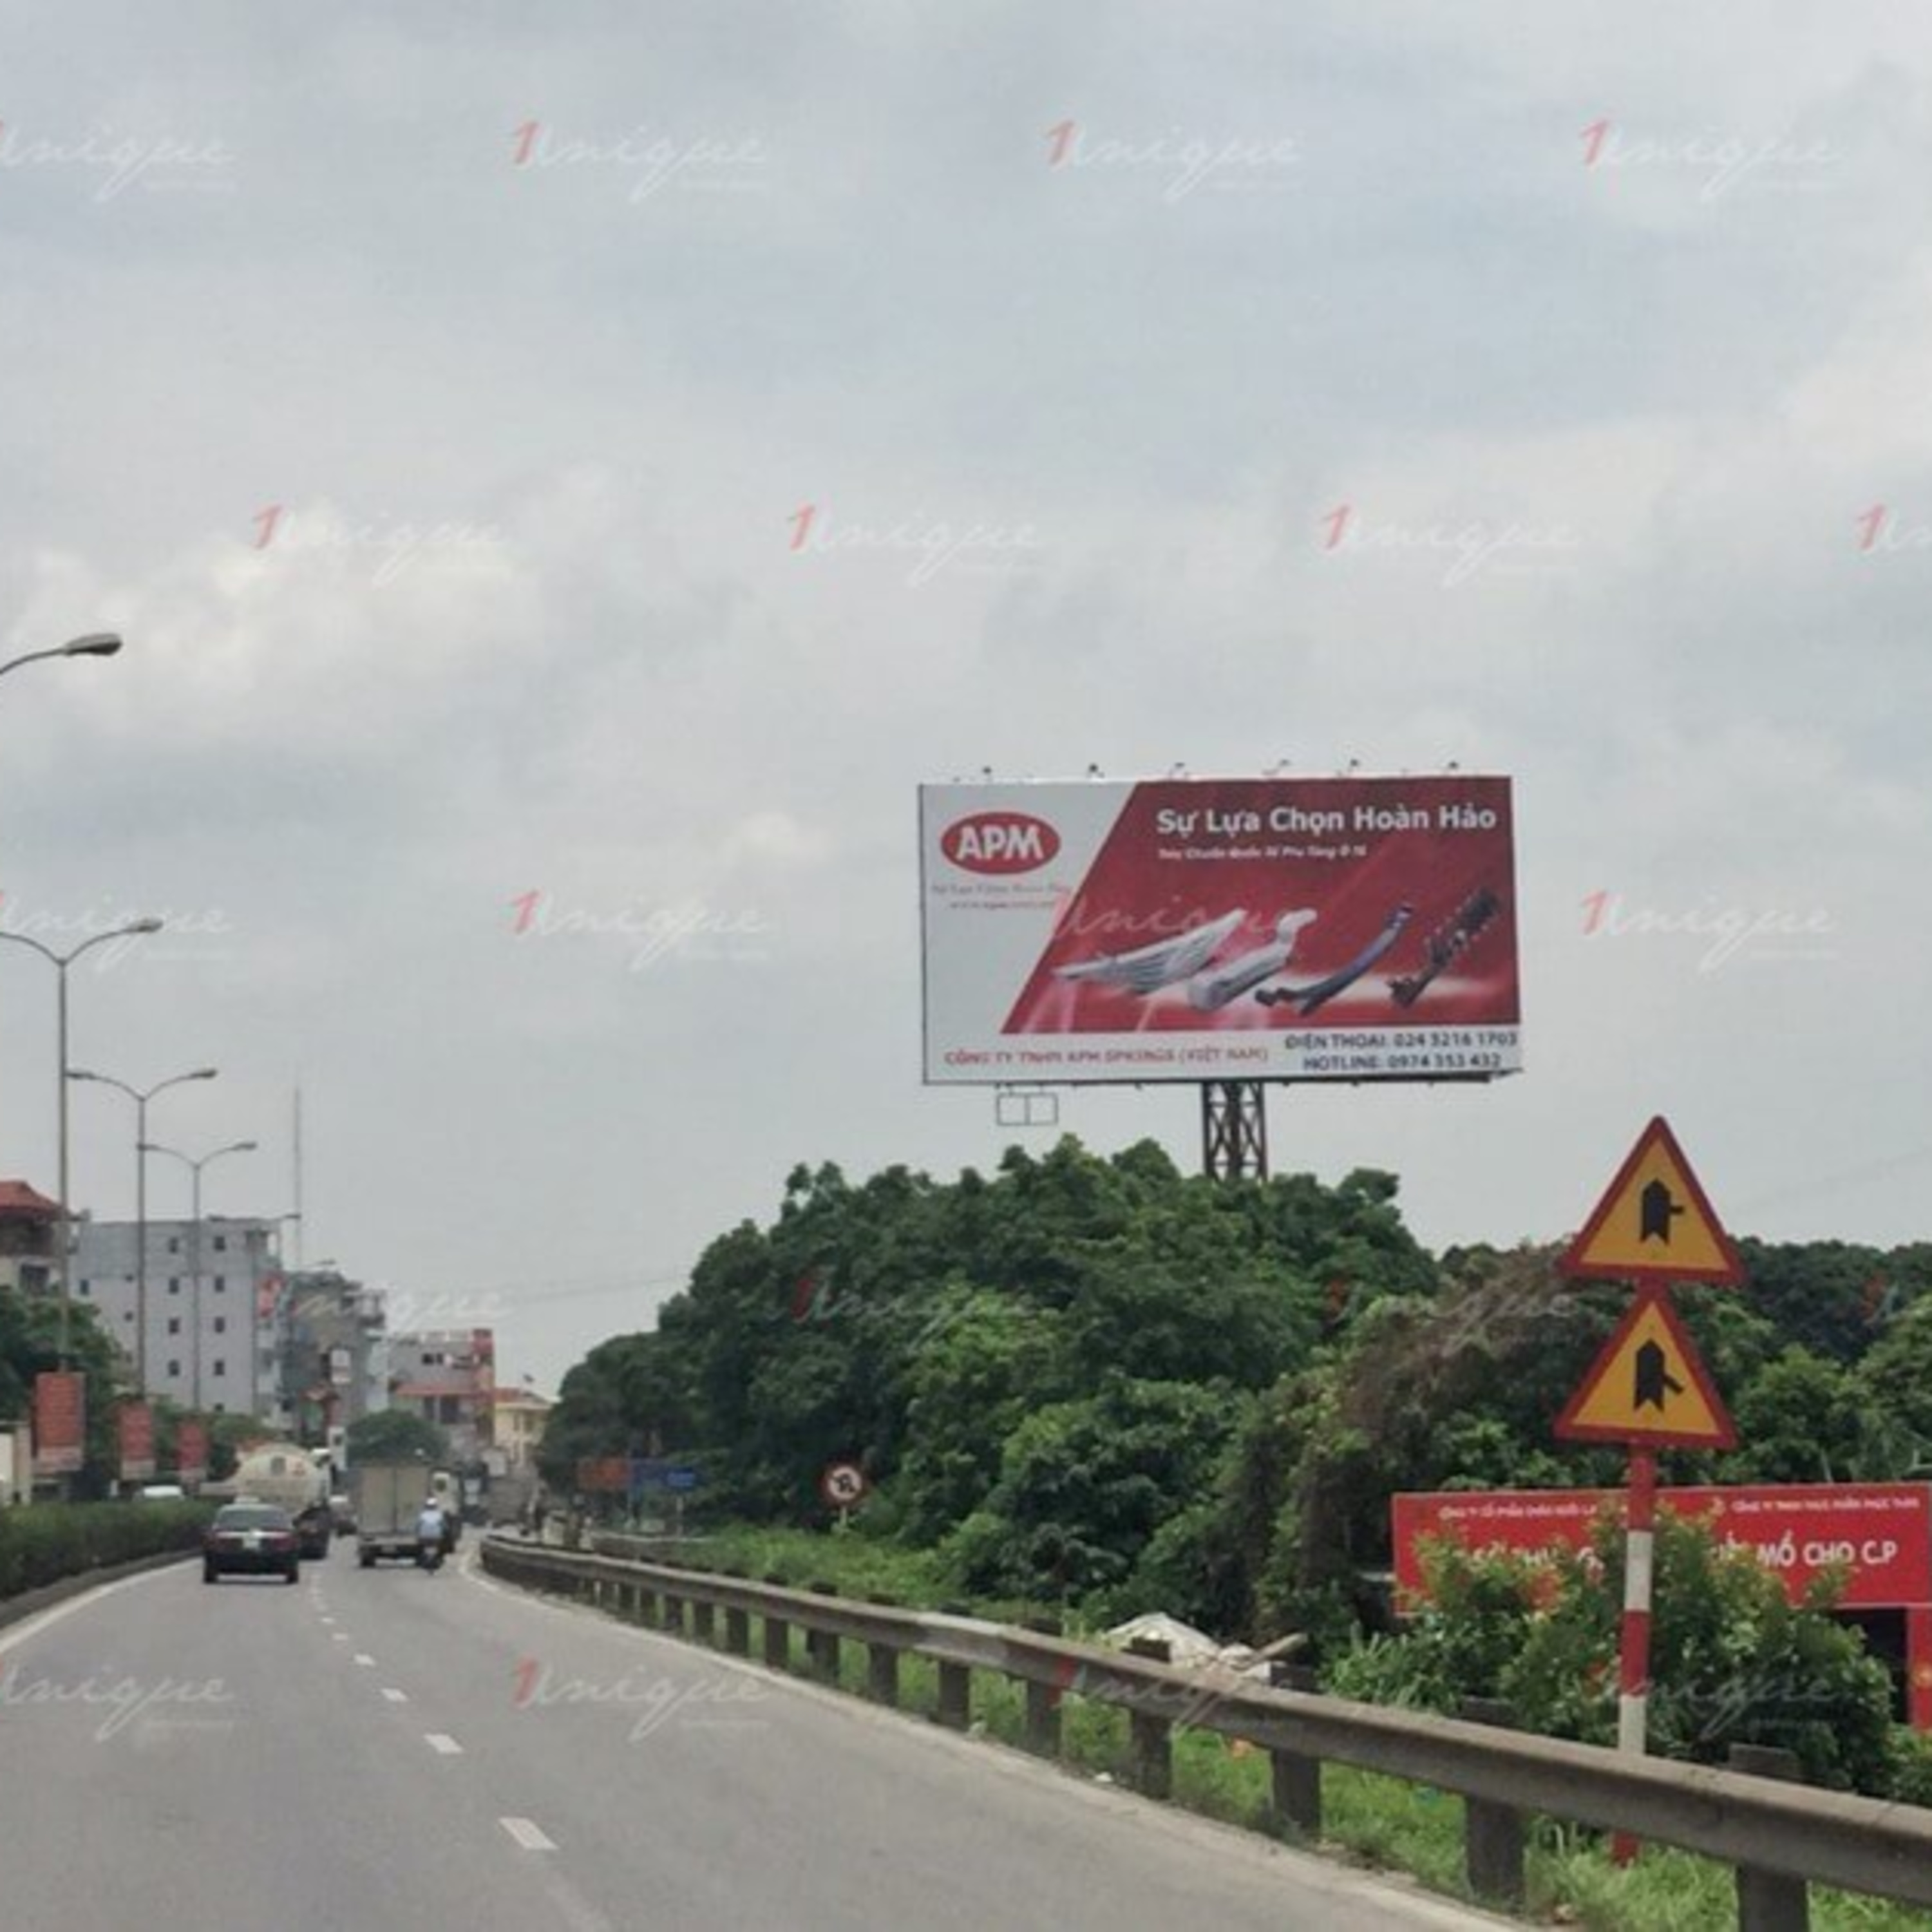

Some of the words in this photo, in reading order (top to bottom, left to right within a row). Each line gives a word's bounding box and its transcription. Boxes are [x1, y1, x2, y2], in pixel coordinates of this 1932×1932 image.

[1157, 809, 1199, 837] Sự
[1206, 809, 1260, 837] Lựa
[1269, 806, 1344, 837] Chọn
[1354, 802, 1430, 831] Hoàn
[1439, 802, 1497, 829] Hảo
[956, 824, 1045, 860] APM
[1393, 1032, 1426, 1047] 024
[1803, 1540, 1855, 1566] CHO
